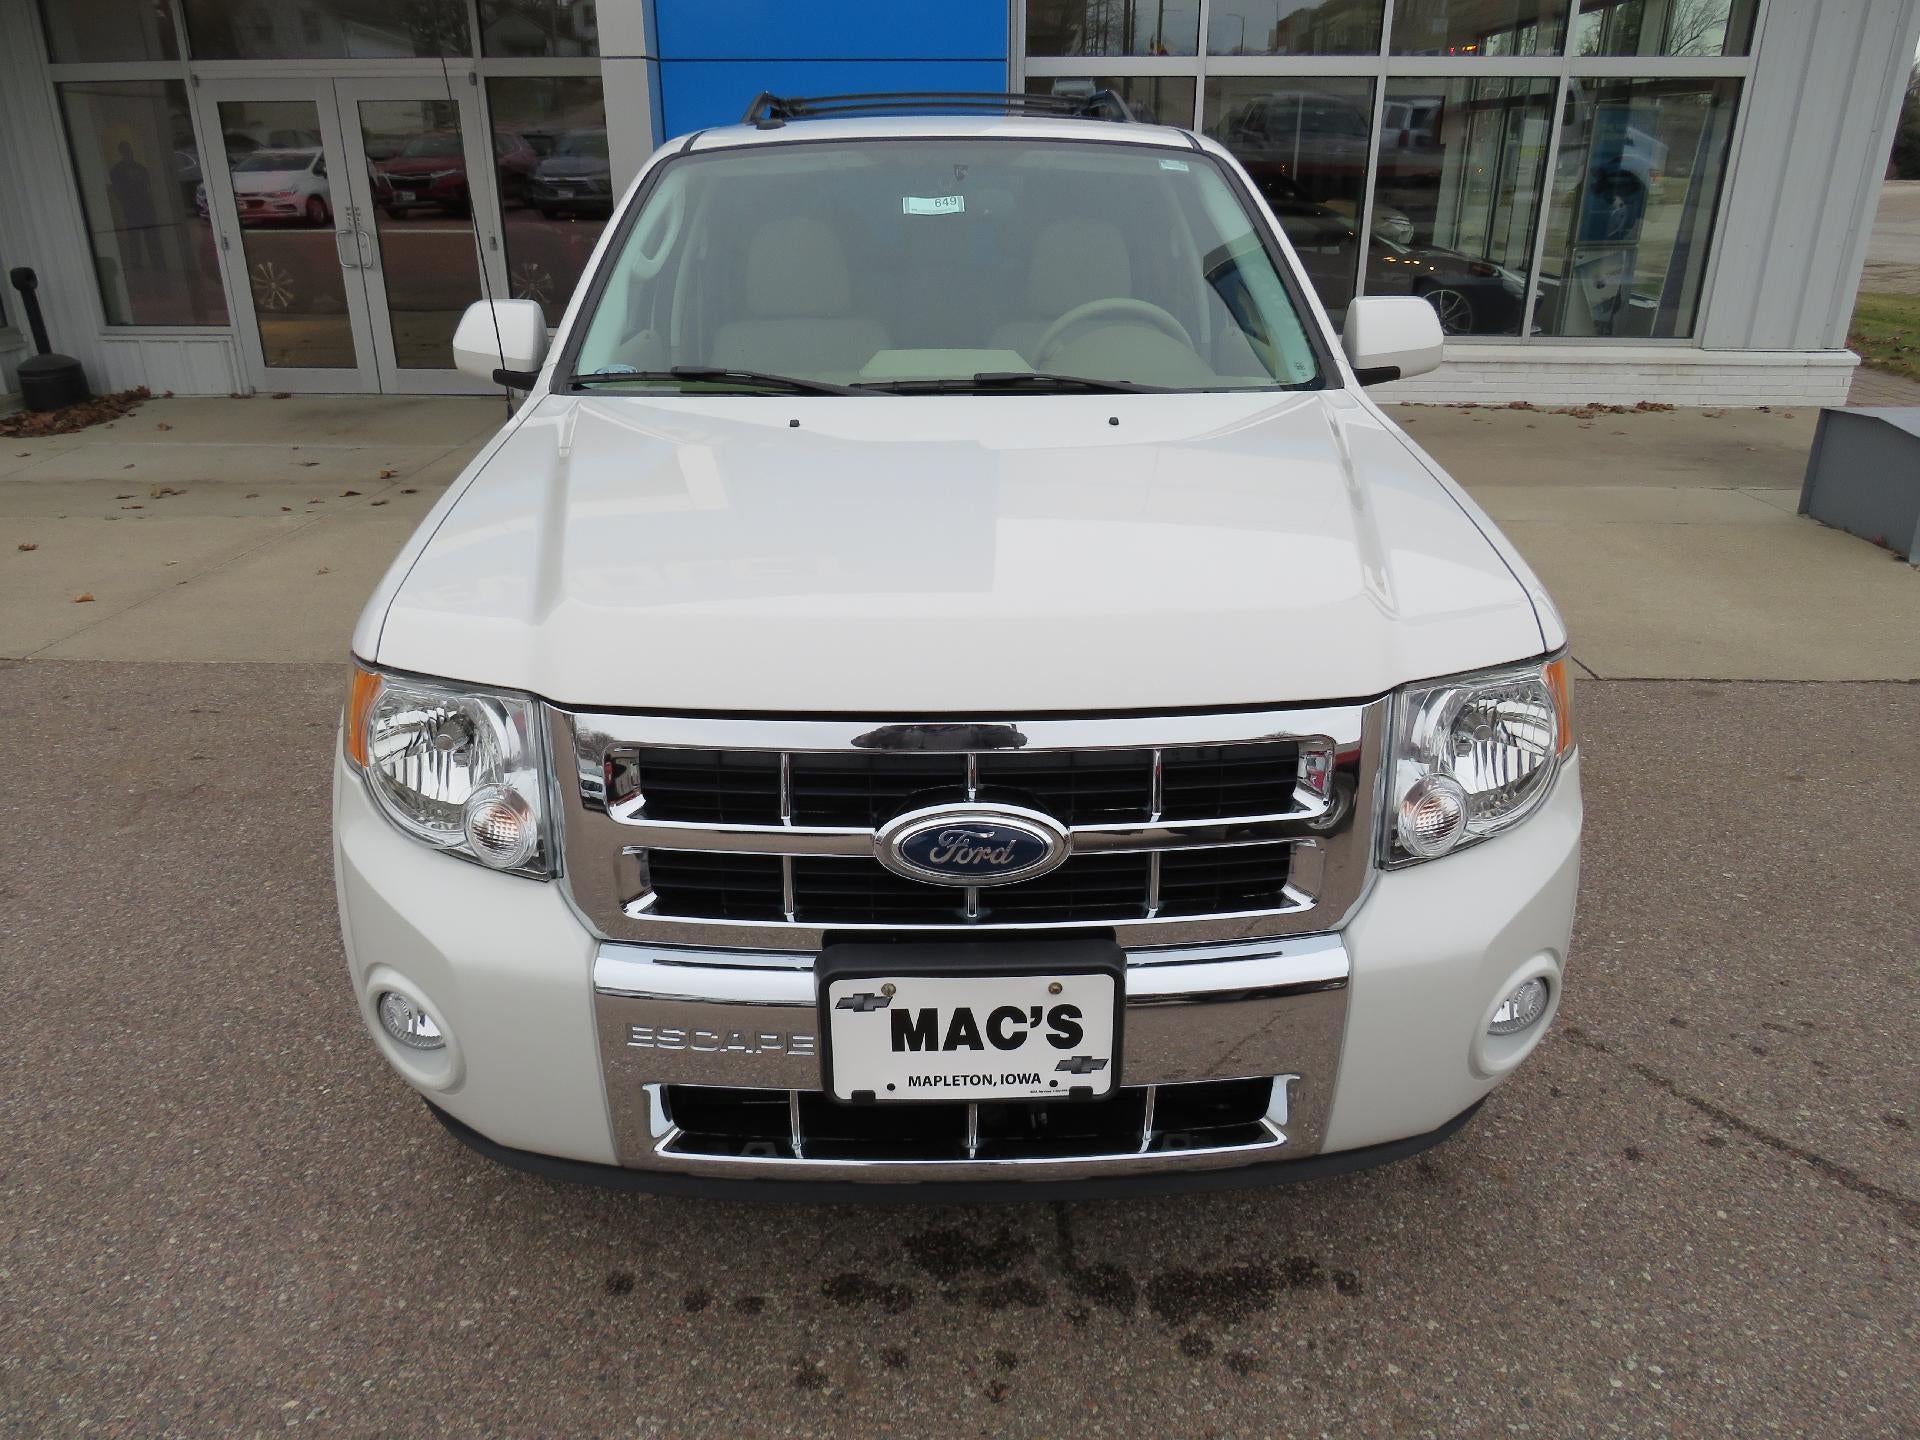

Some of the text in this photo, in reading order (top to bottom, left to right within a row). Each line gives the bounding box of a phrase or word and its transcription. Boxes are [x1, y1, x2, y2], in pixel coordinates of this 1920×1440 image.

[934, 197, 957, 208] 649
[929, 829, 1016, 865] Ford
[626, 1024, 815, 1056] ESCAPE
[890, 1003, 1084, 1052] MAC'S
[1000, 1073, 1041, 1085] IOWA
